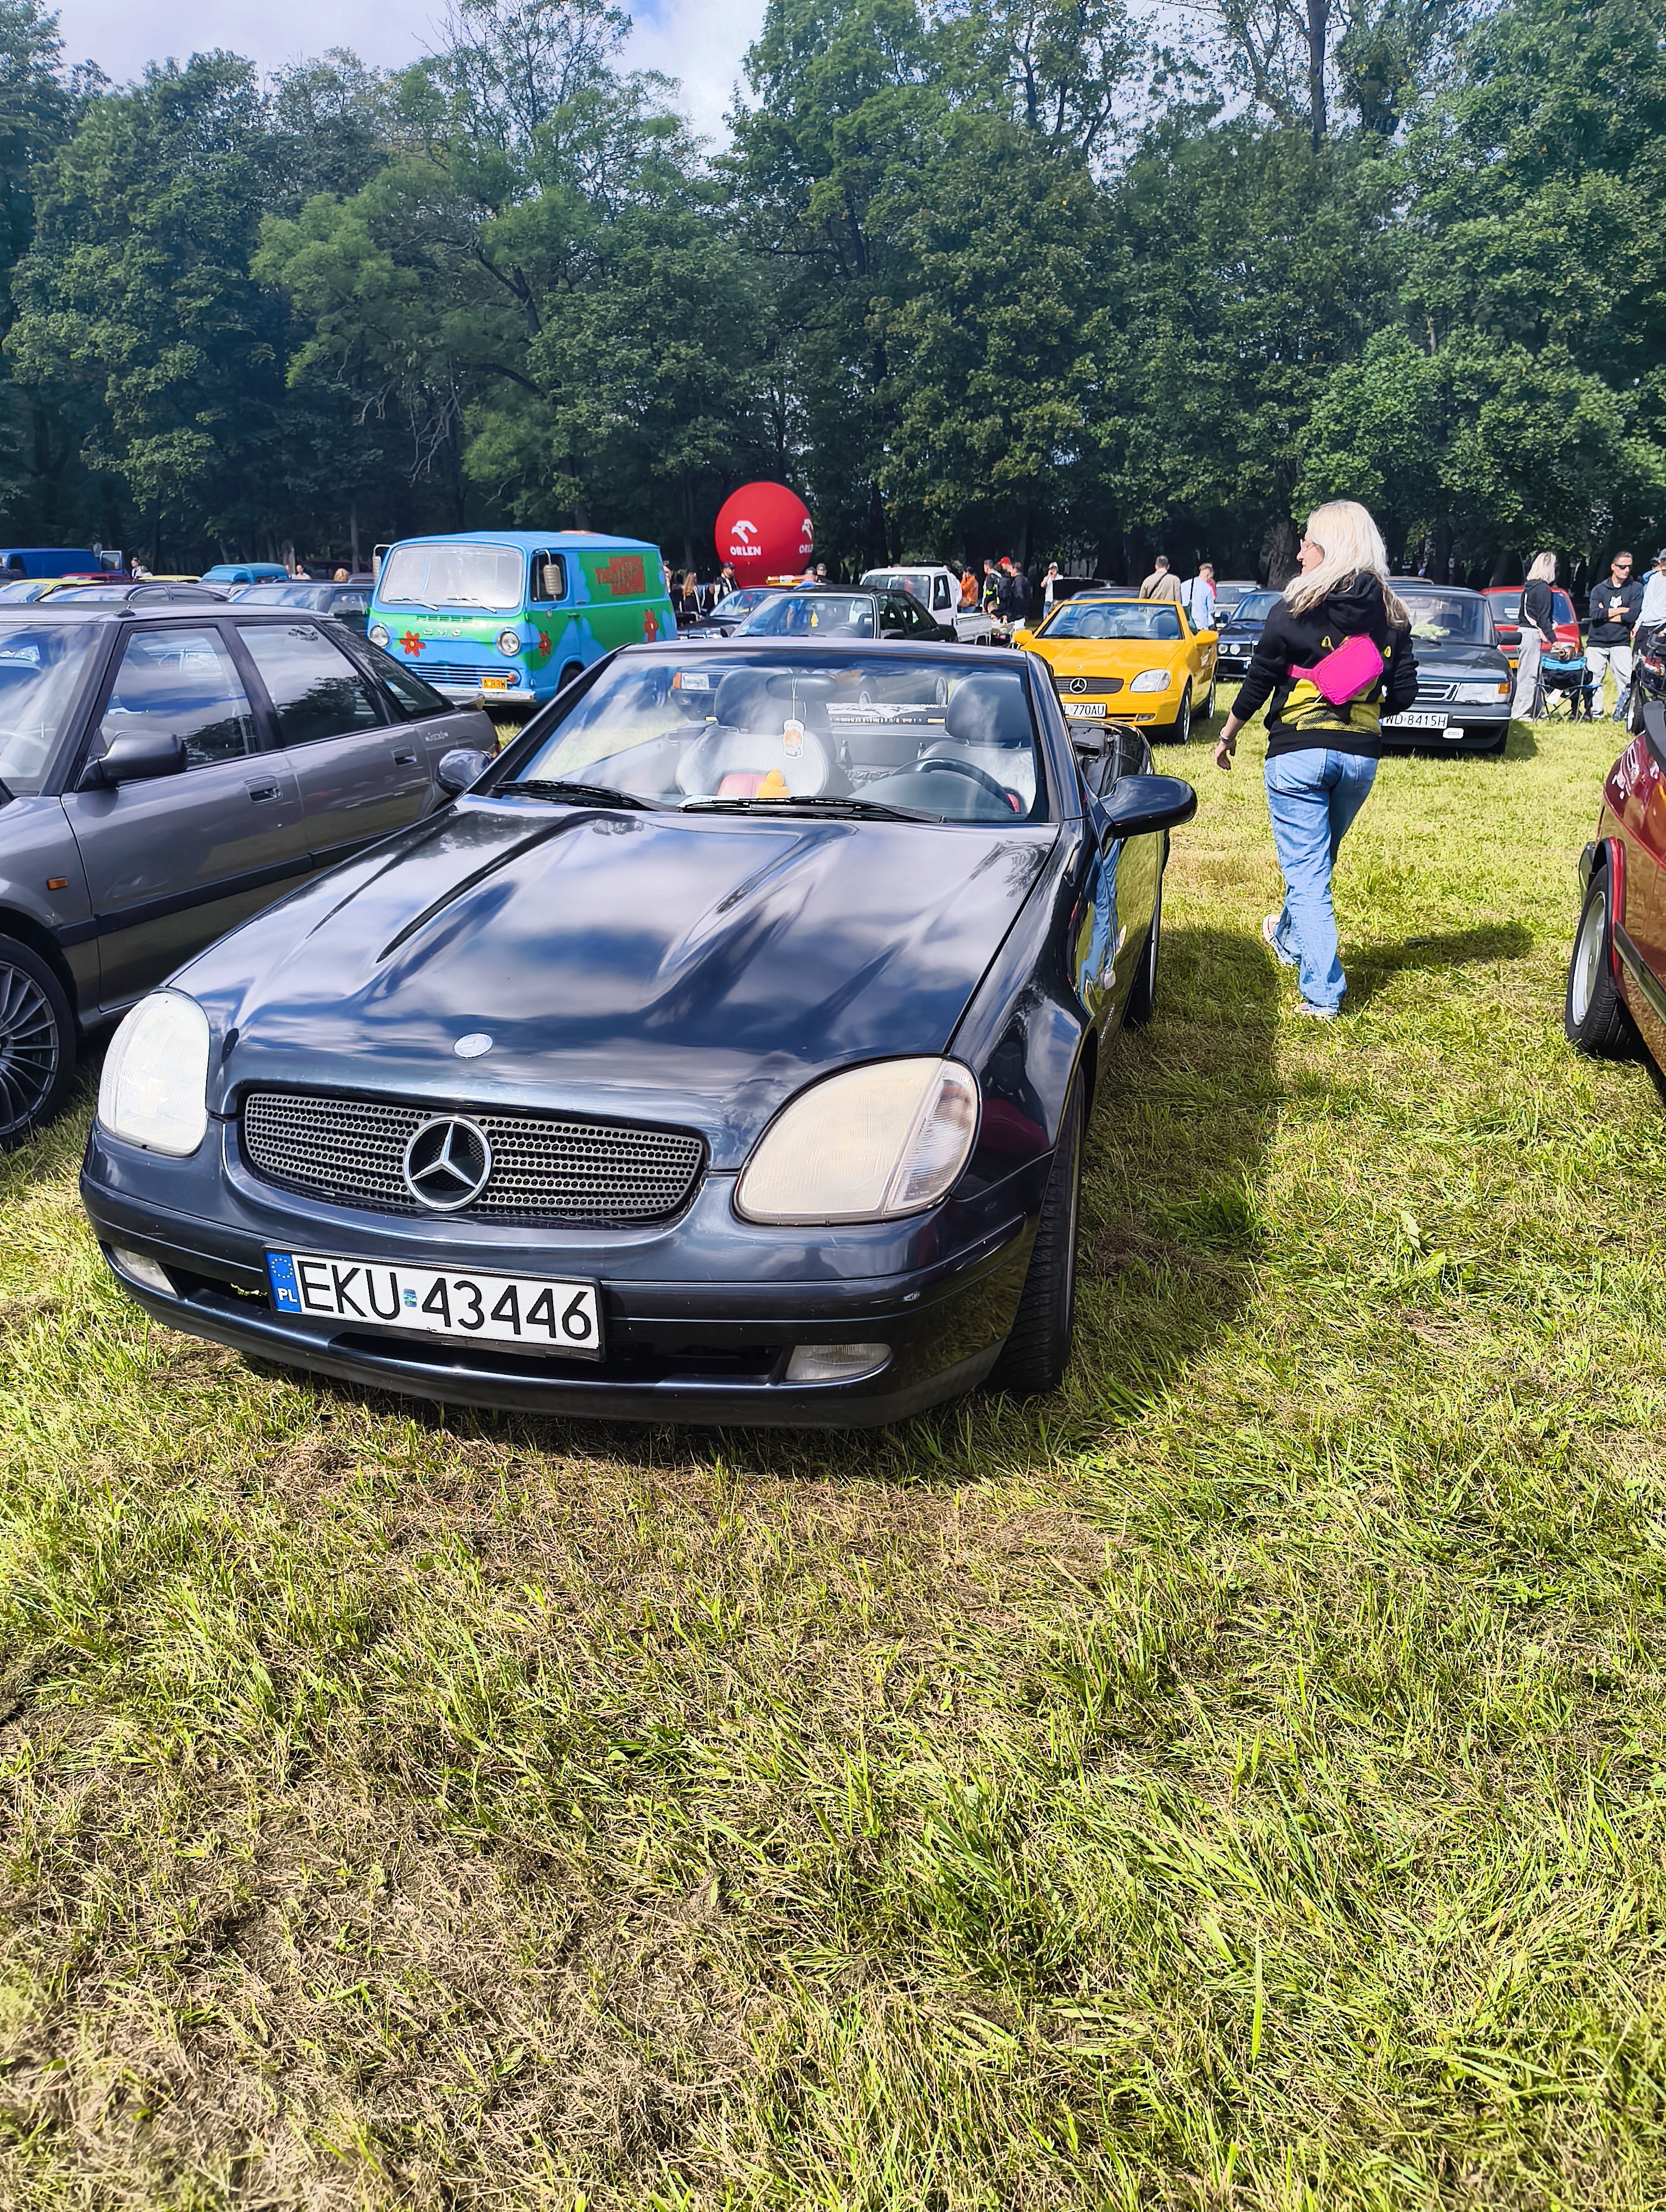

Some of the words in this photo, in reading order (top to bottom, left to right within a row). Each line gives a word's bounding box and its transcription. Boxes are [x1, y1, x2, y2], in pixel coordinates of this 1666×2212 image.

[730, 546, 761, 556] ORLEN
[423, 628, 462, 636] GMC
[1063, 705, 1069, 716] L
[1073, 705, 1104, 715] 770AU
[1386, 714, 1403, 725] WD
[1407, 715, 1446, 726] 8415H
[277, 1287, 298, 1303] PL
[297, 1260, 400, 1320] EKU
[421, 1277, 592, 1341] 43446
